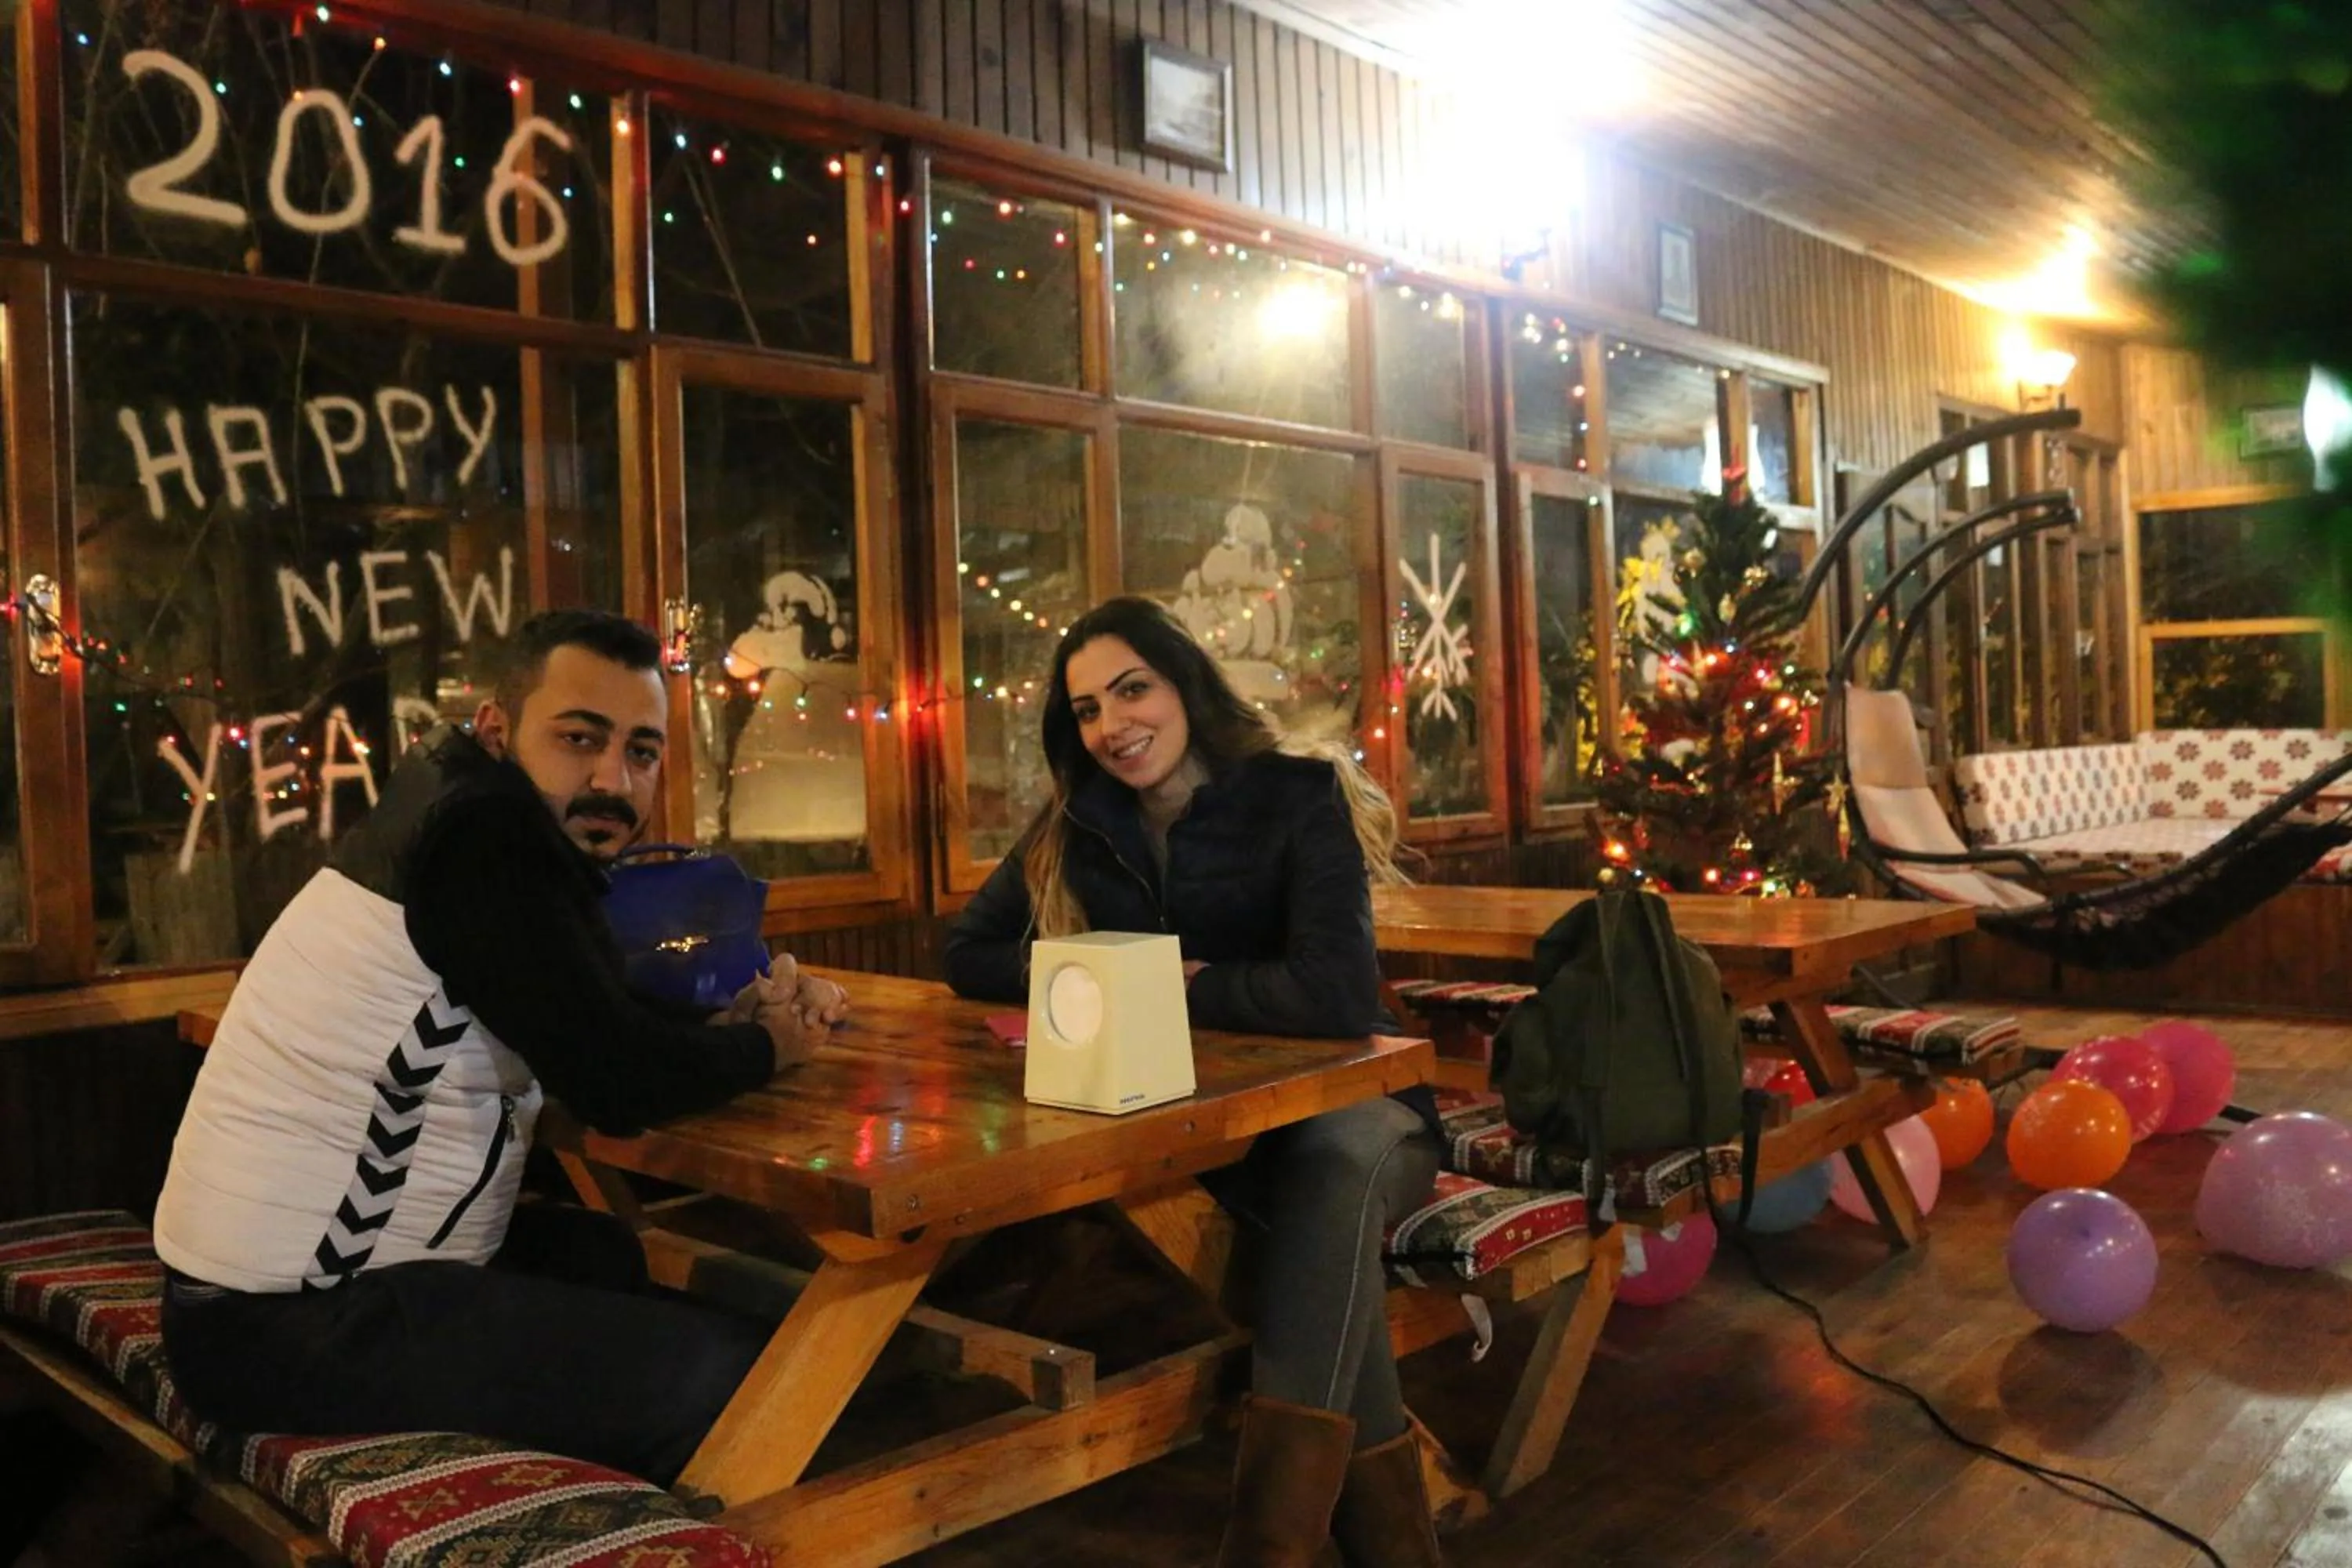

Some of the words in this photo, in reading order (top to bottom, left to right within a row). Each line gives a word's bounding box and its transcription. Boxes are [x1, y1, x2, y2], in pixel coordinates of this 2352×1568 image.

[123, 49, 571, 266] 2016
[118, 384, 497, 521] HAPPY
[276, 546, 514, 656] NEW
